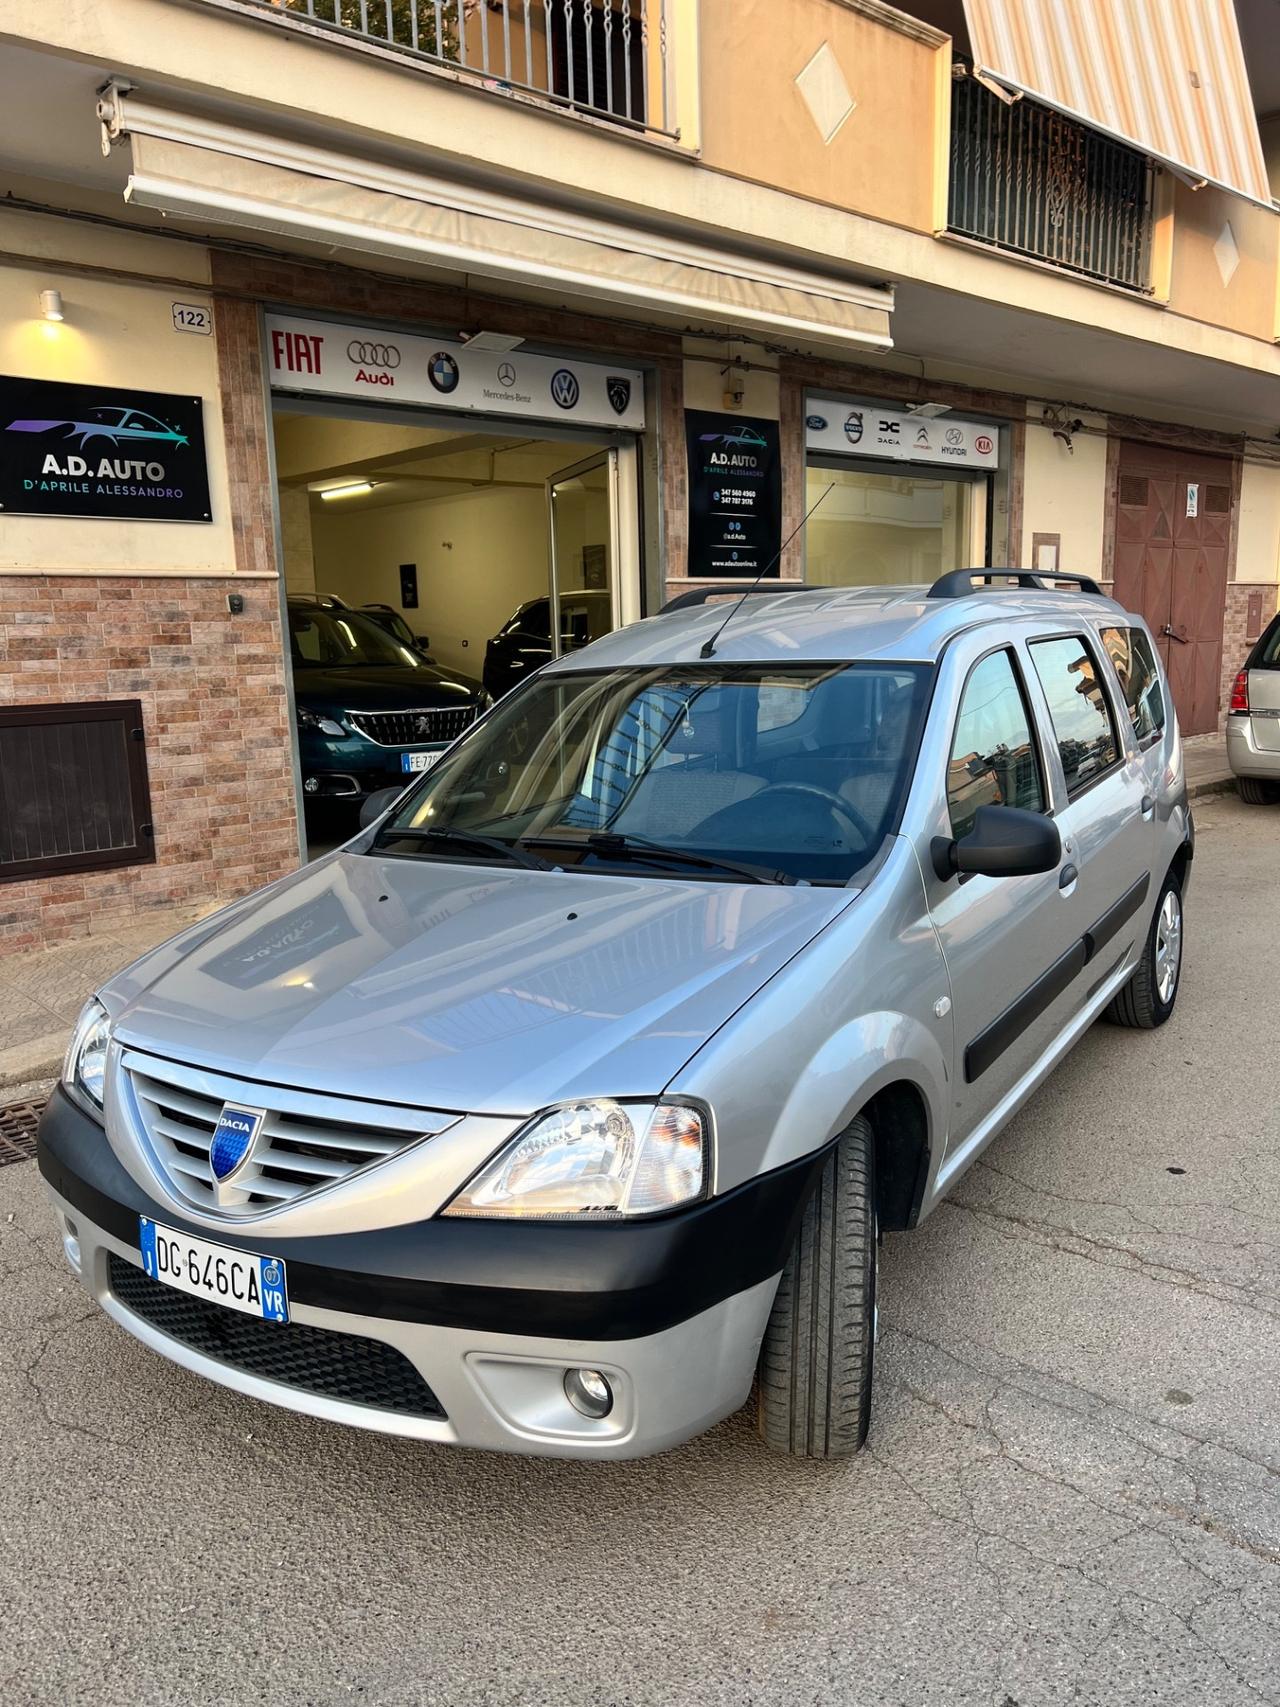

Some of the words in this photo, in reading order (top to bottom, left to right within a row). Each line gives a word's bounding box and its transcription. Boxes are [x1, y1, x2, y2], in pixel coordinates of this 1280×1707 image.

[177, 309, 206, 328] 122
[272, 330, 324, 375] FIAT
[355, 369, 395, 386] Audi
[483, 388, 532, 403] Mercedes-Benz
[877, 437, 901, 446] DACIA
[978, 440, 991, 451] KIA
[42, 454, 95, 478] A.D.
[97, 458, 165, 482] AUTO
[731, 454, 757, 468] AUTO
[96, 484, 184, 498] ALESSANDRO
[721, 488, 731, 496] 347
[220, 1117, 250, 1132] DACIA
[264, 1289, 284, 1313] VR
